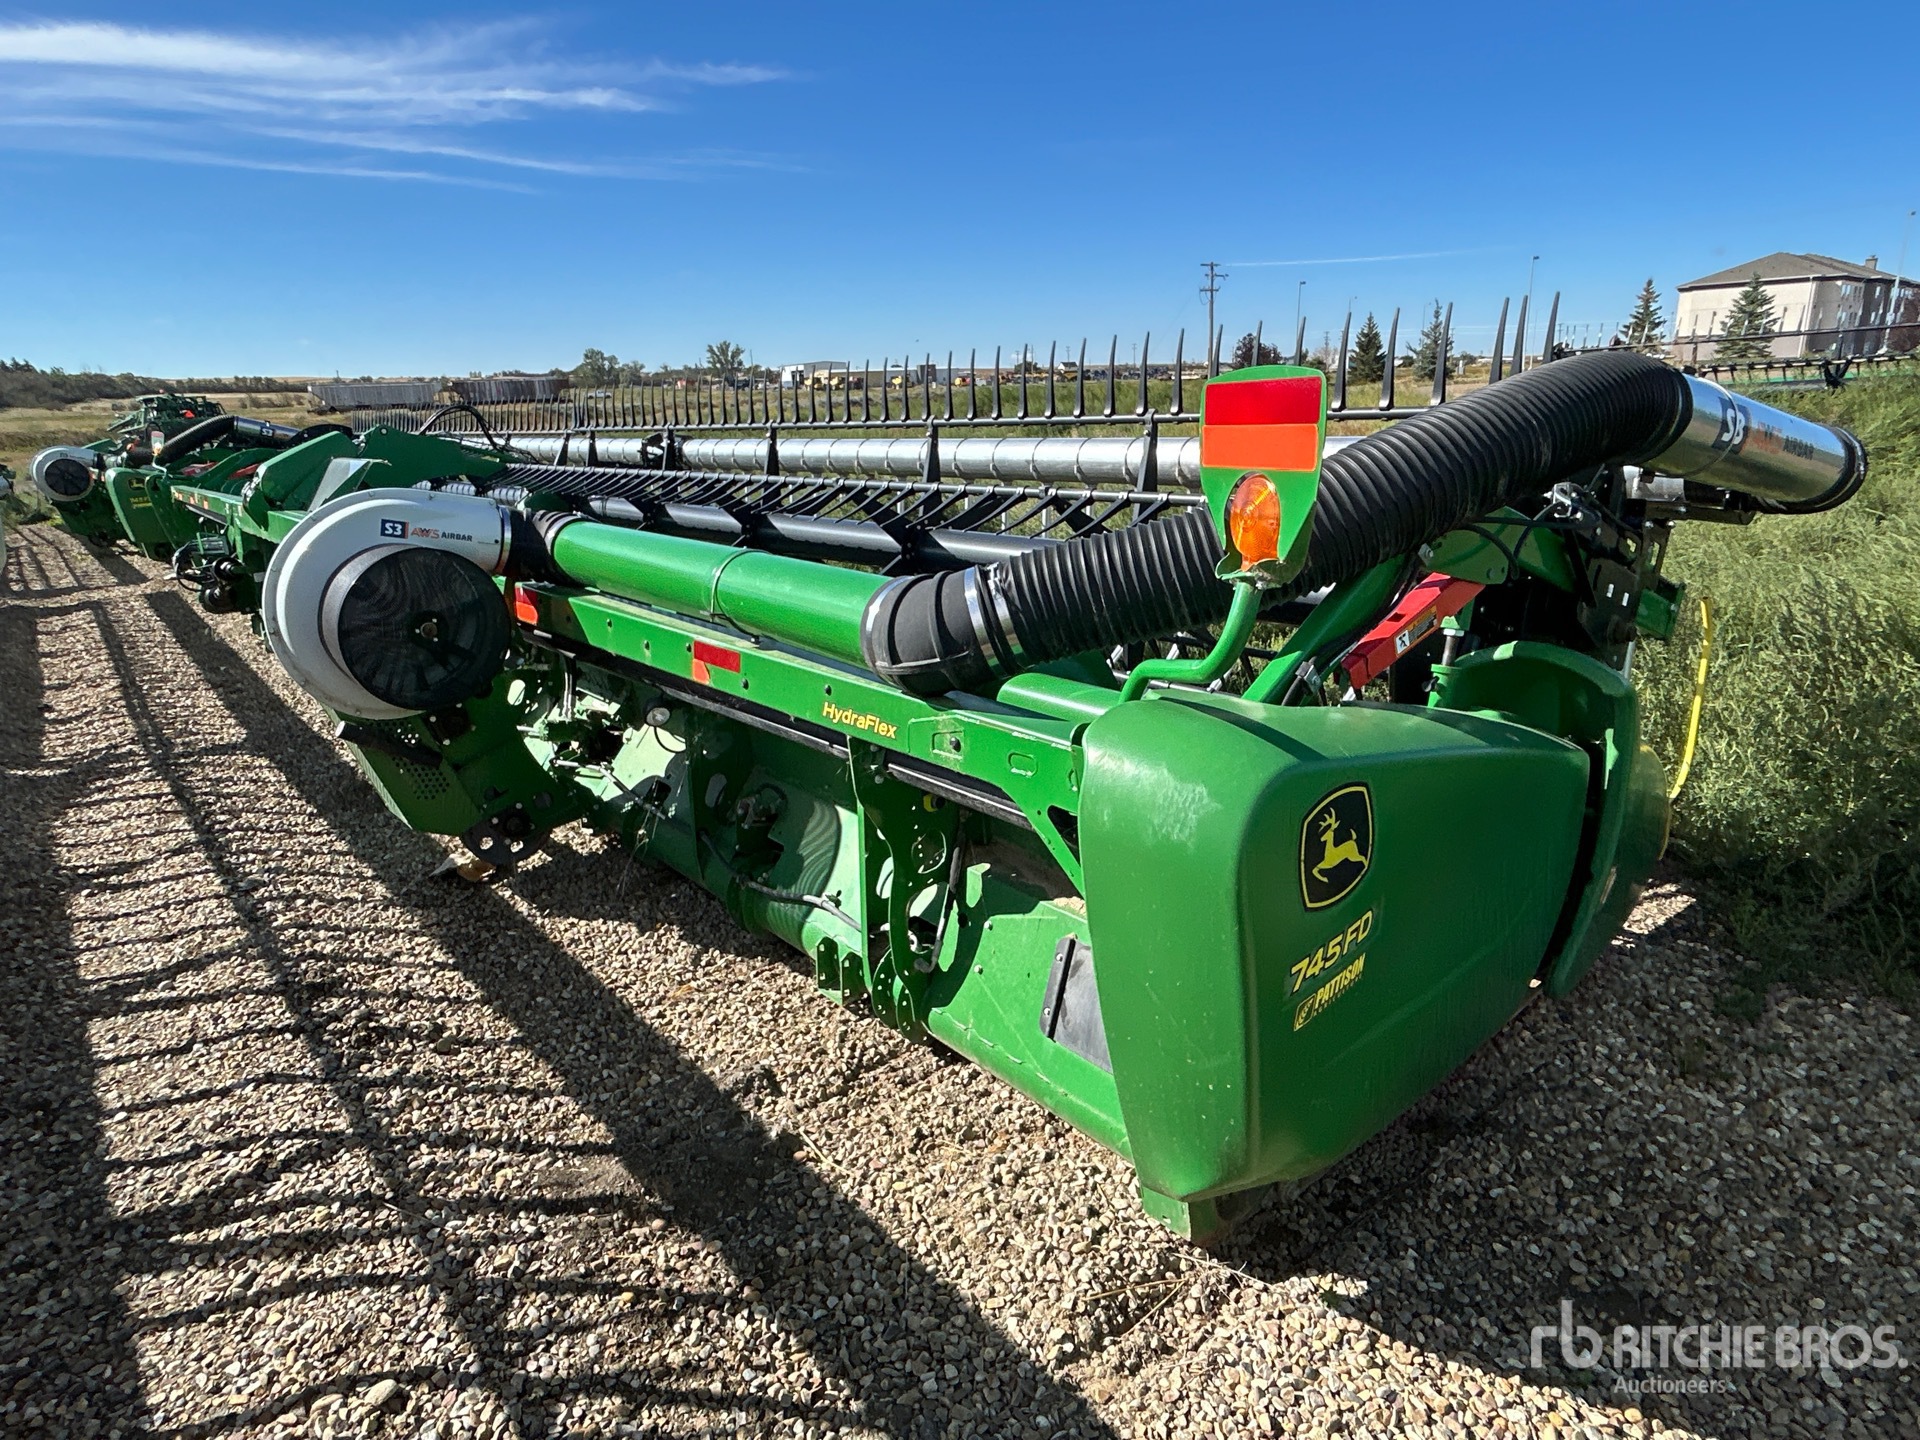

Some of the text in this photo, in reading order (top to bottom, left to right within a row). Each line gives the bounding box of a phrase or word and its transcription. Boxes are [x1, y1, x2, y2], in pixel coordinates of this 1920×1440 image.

[384, 522, 473, 542] S3 AWS AIRBAR
[822, 701, 898, 740] HydraFlex
[1290, 909, 1374, 993] 745FD
[1314, 952, 1366, 1010] PATTISON
